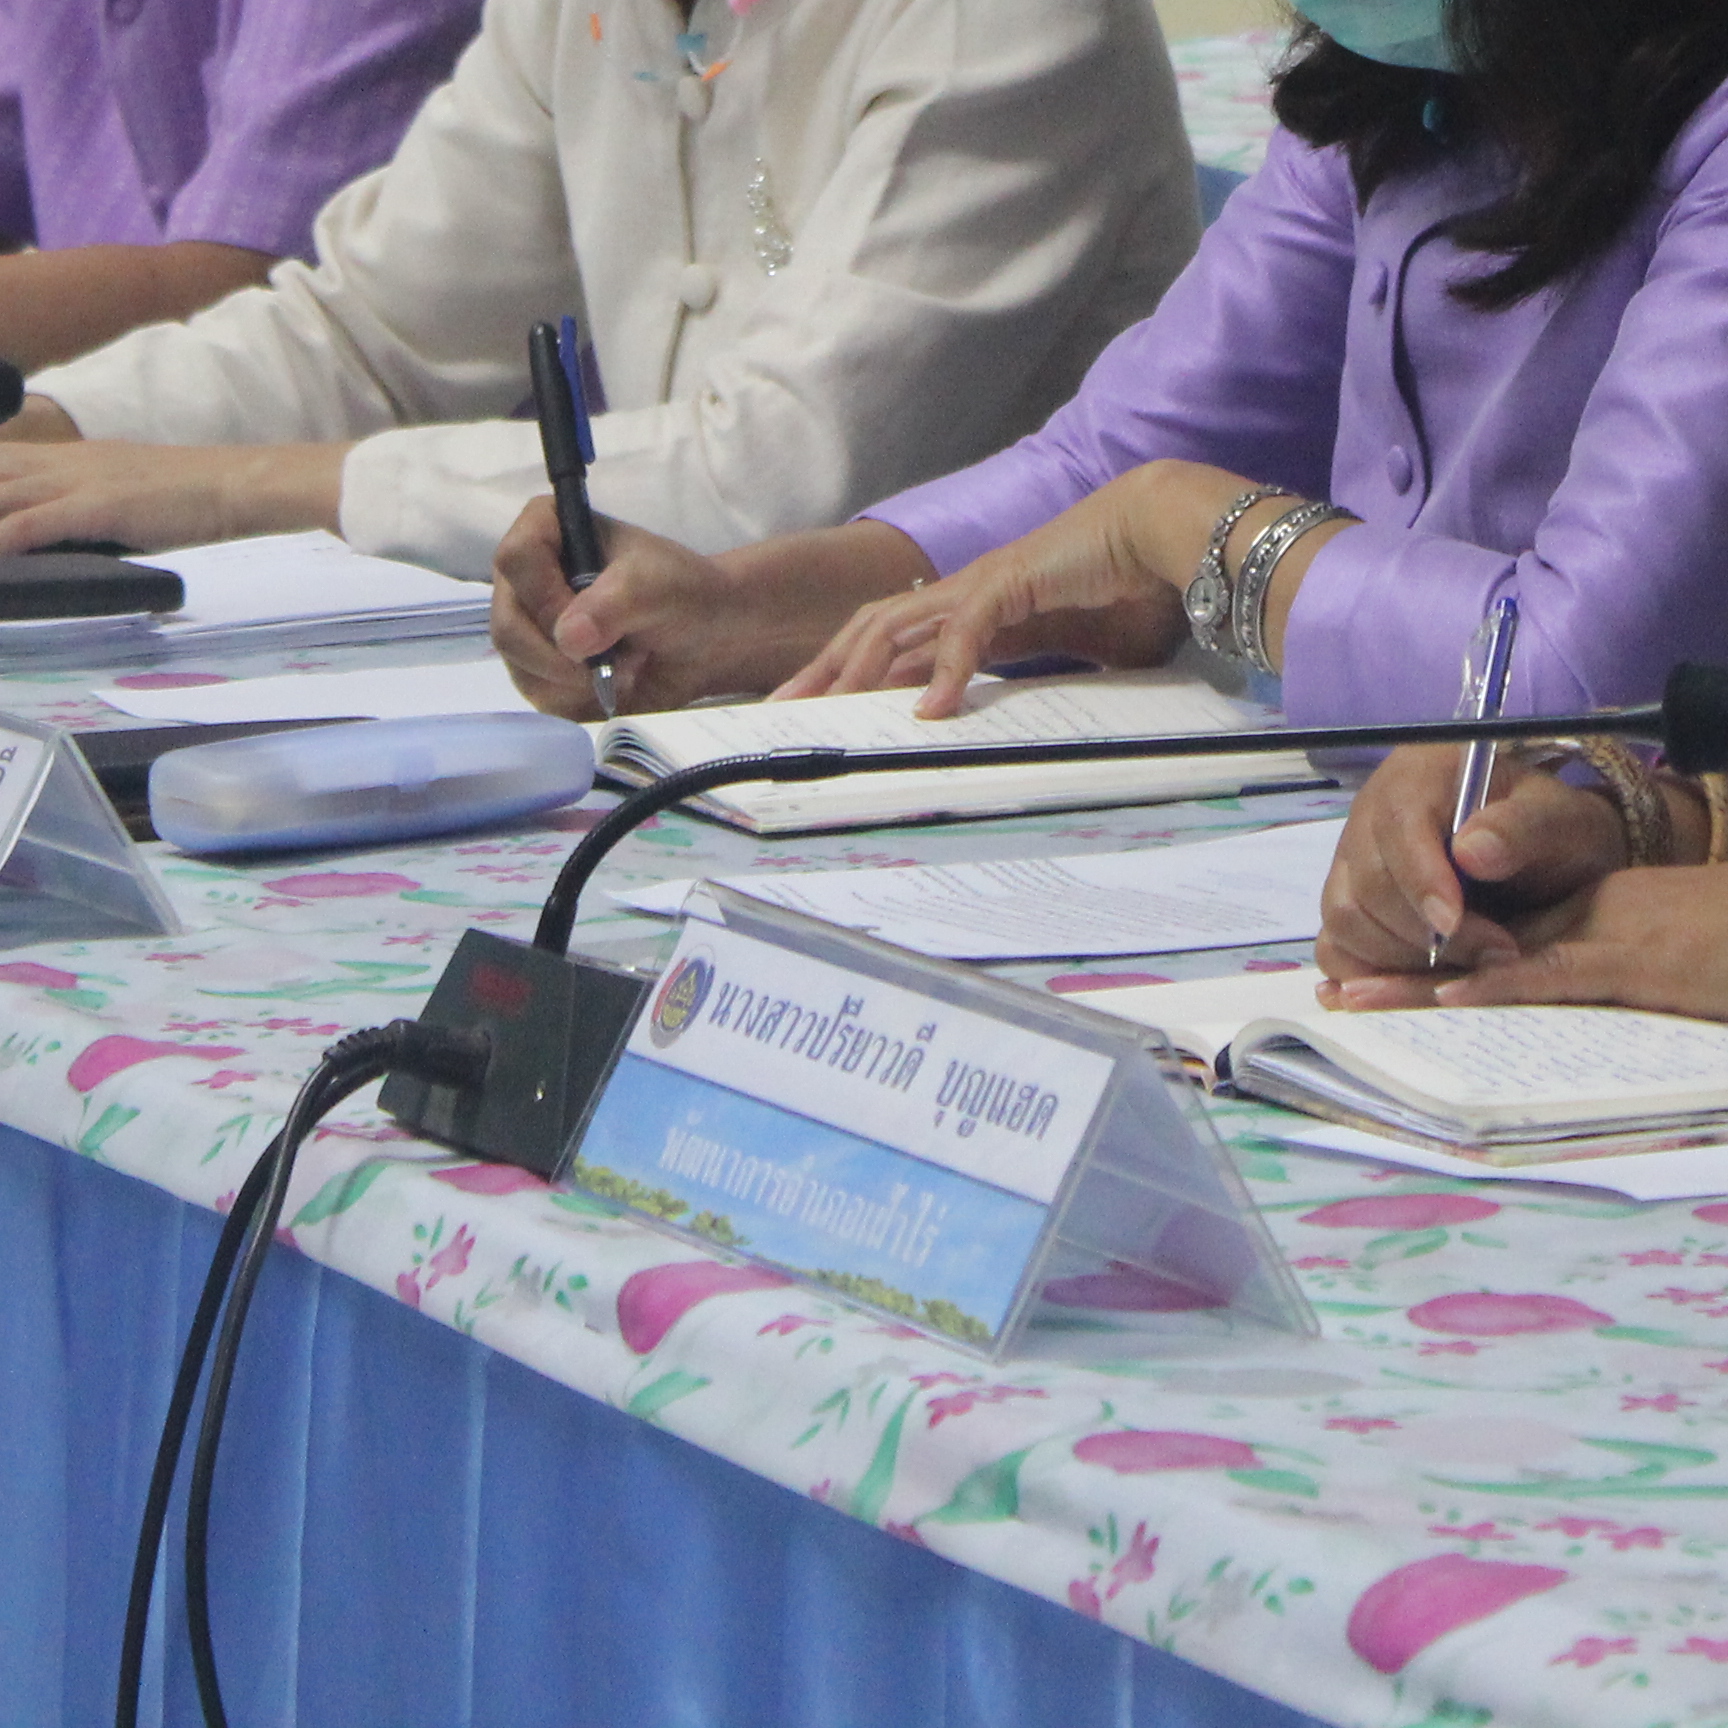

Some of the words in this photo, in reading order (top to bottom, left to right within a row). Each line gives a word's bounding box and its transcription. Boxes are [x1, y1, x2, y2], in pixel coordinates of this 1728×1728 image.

[708, 977, 937, 1094] นางสาวปรียาวดี
